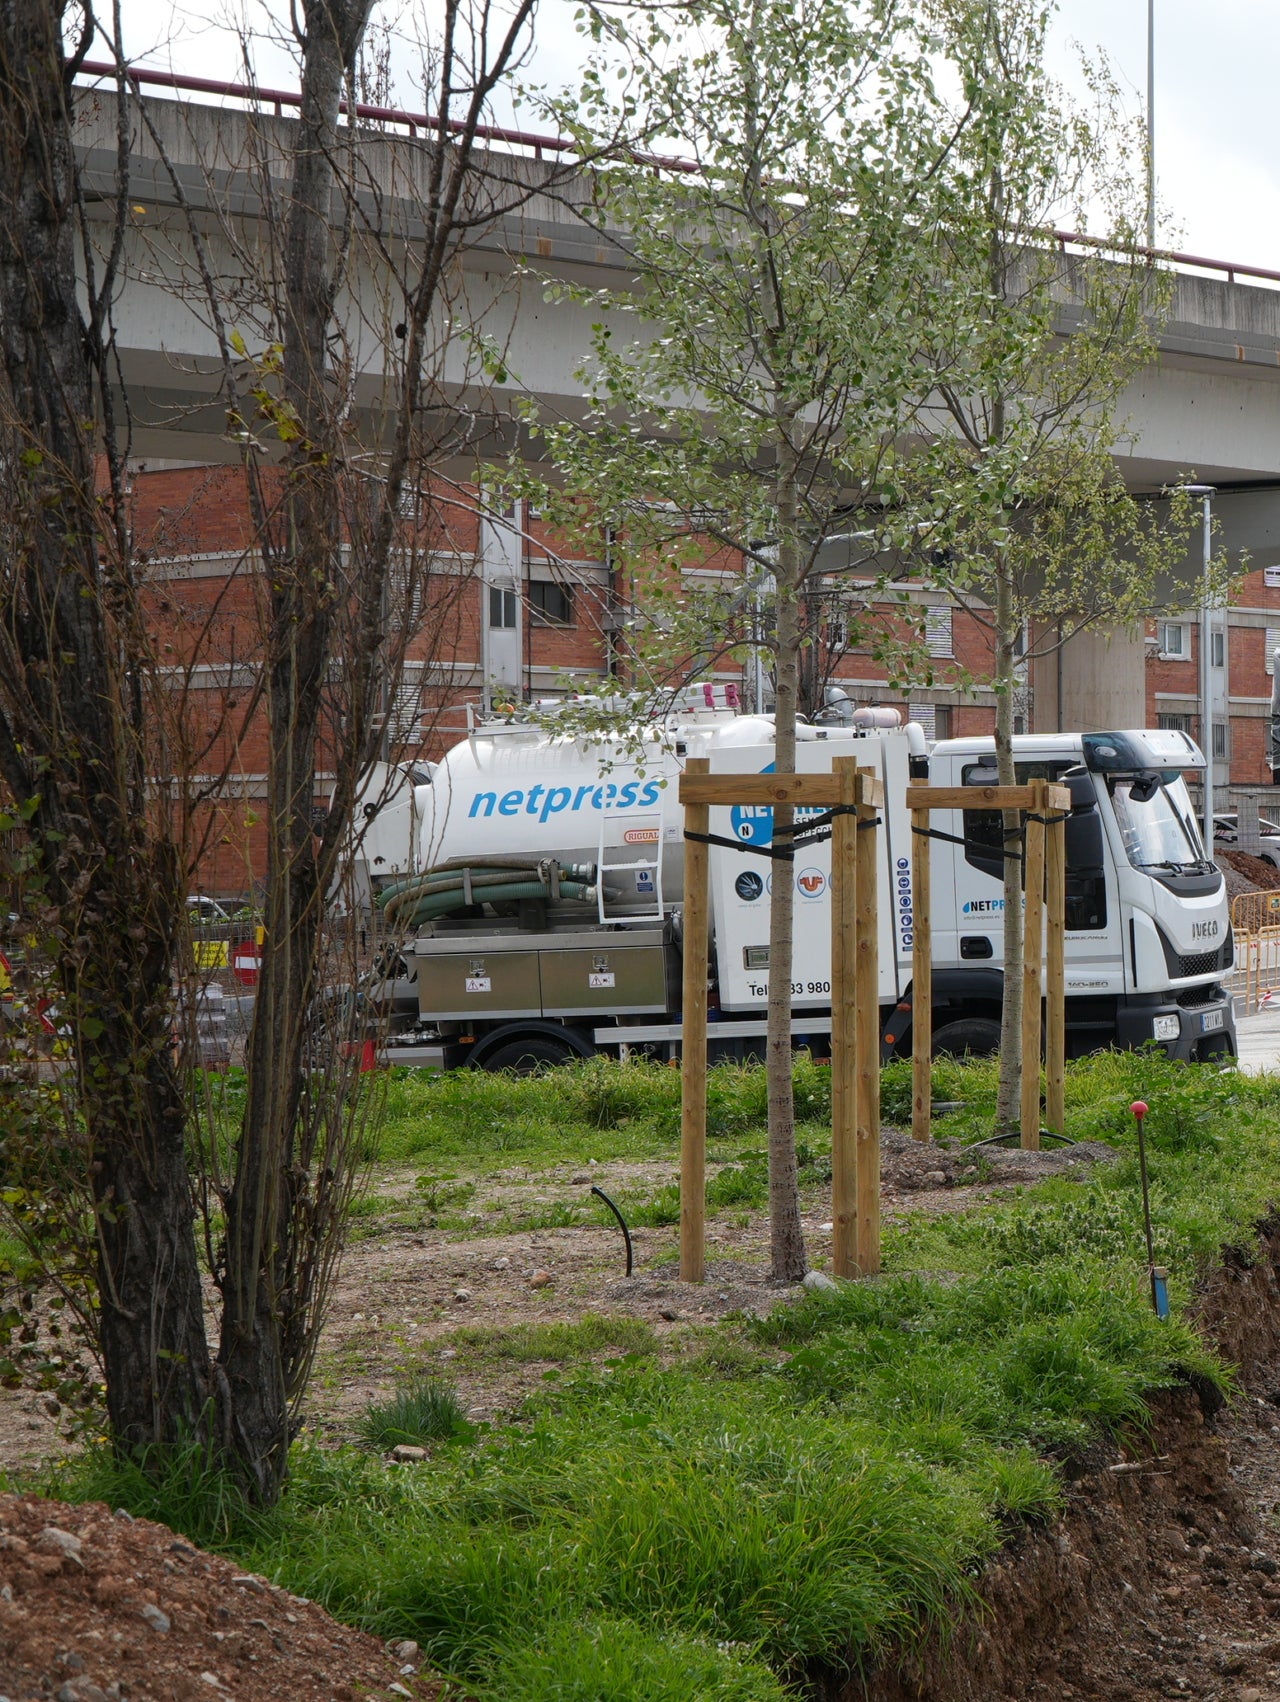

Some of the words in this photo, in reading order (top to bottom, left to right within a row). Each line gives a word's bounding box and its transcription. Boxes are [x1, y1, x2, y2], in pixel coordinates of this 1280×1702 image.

[468, 780, 662, 823] netpress
[1192, 920, 1218, 939] IVECO
[807, 981, 831, 994] 980
